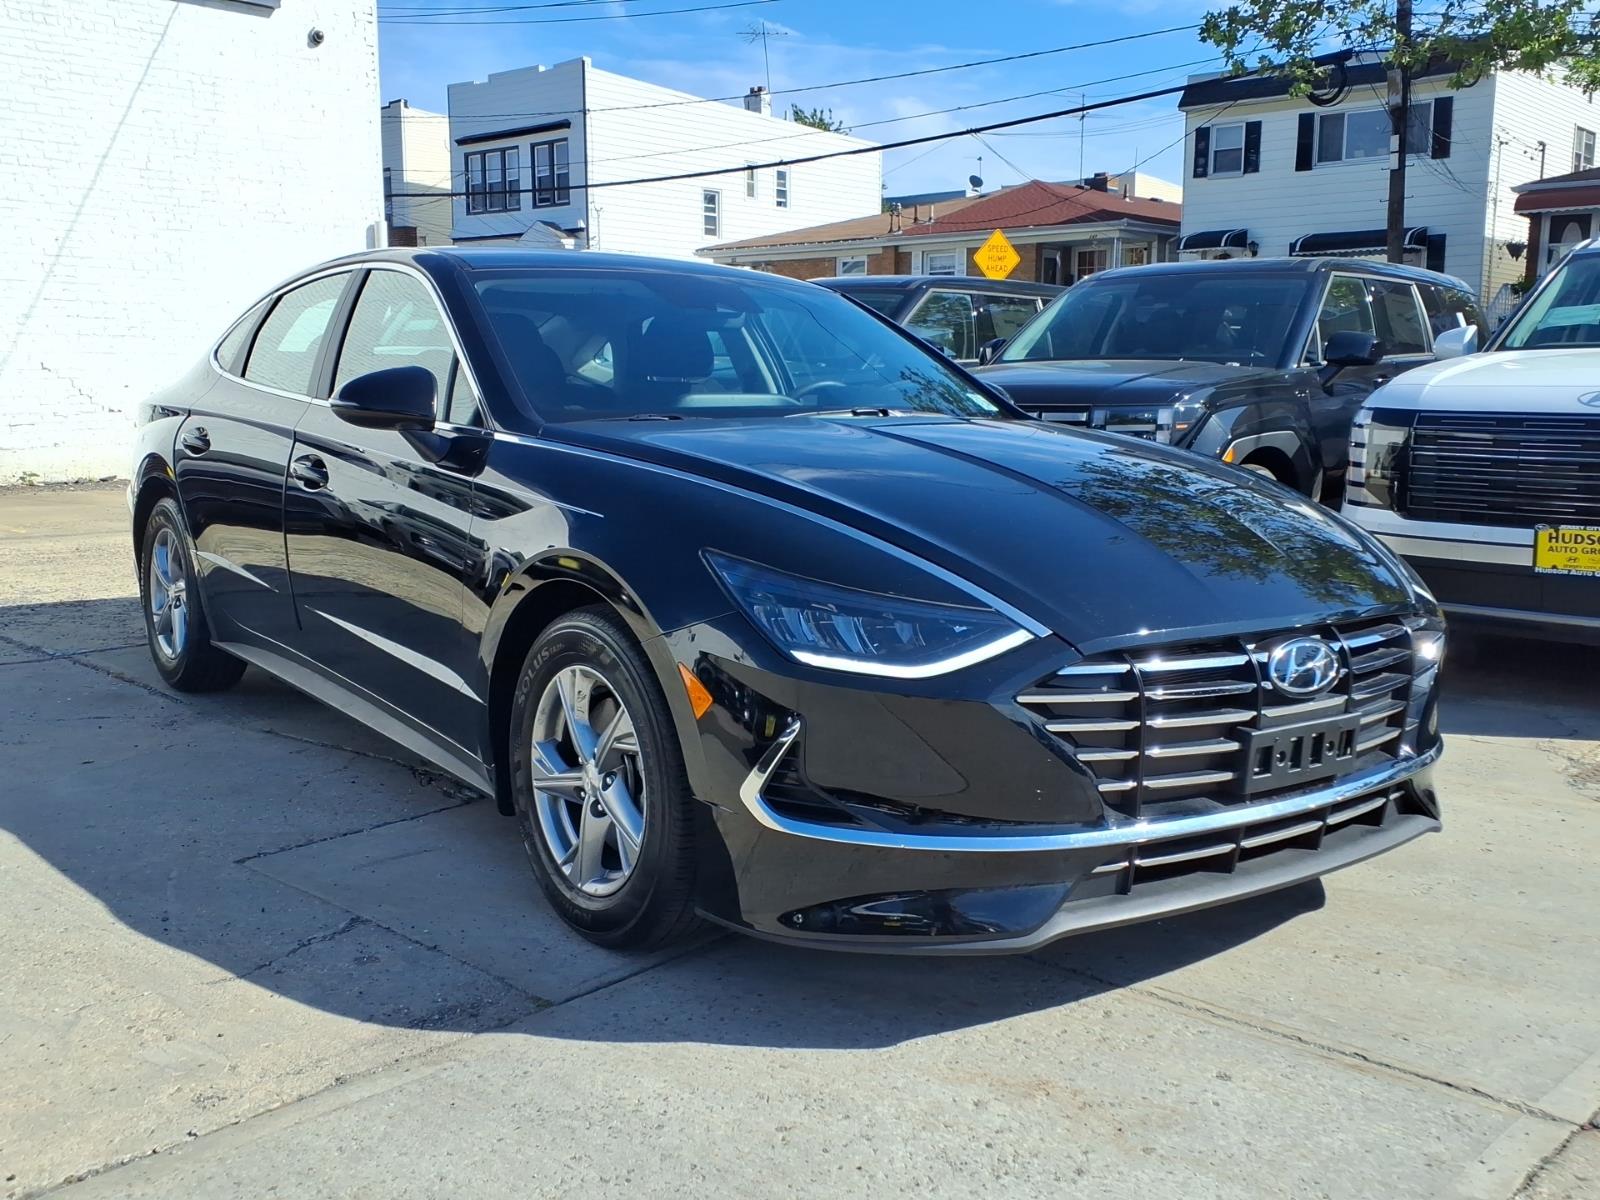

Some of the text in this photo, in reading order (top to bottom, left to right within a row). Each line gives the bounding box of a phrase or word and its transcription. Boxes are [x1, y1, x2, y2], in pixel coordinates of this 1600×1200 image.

[1548, 532, 1600, 545] HUDS
[1547, 546, 1578, 554] AUTO
[518, 646, 550, 707] SOLUS
